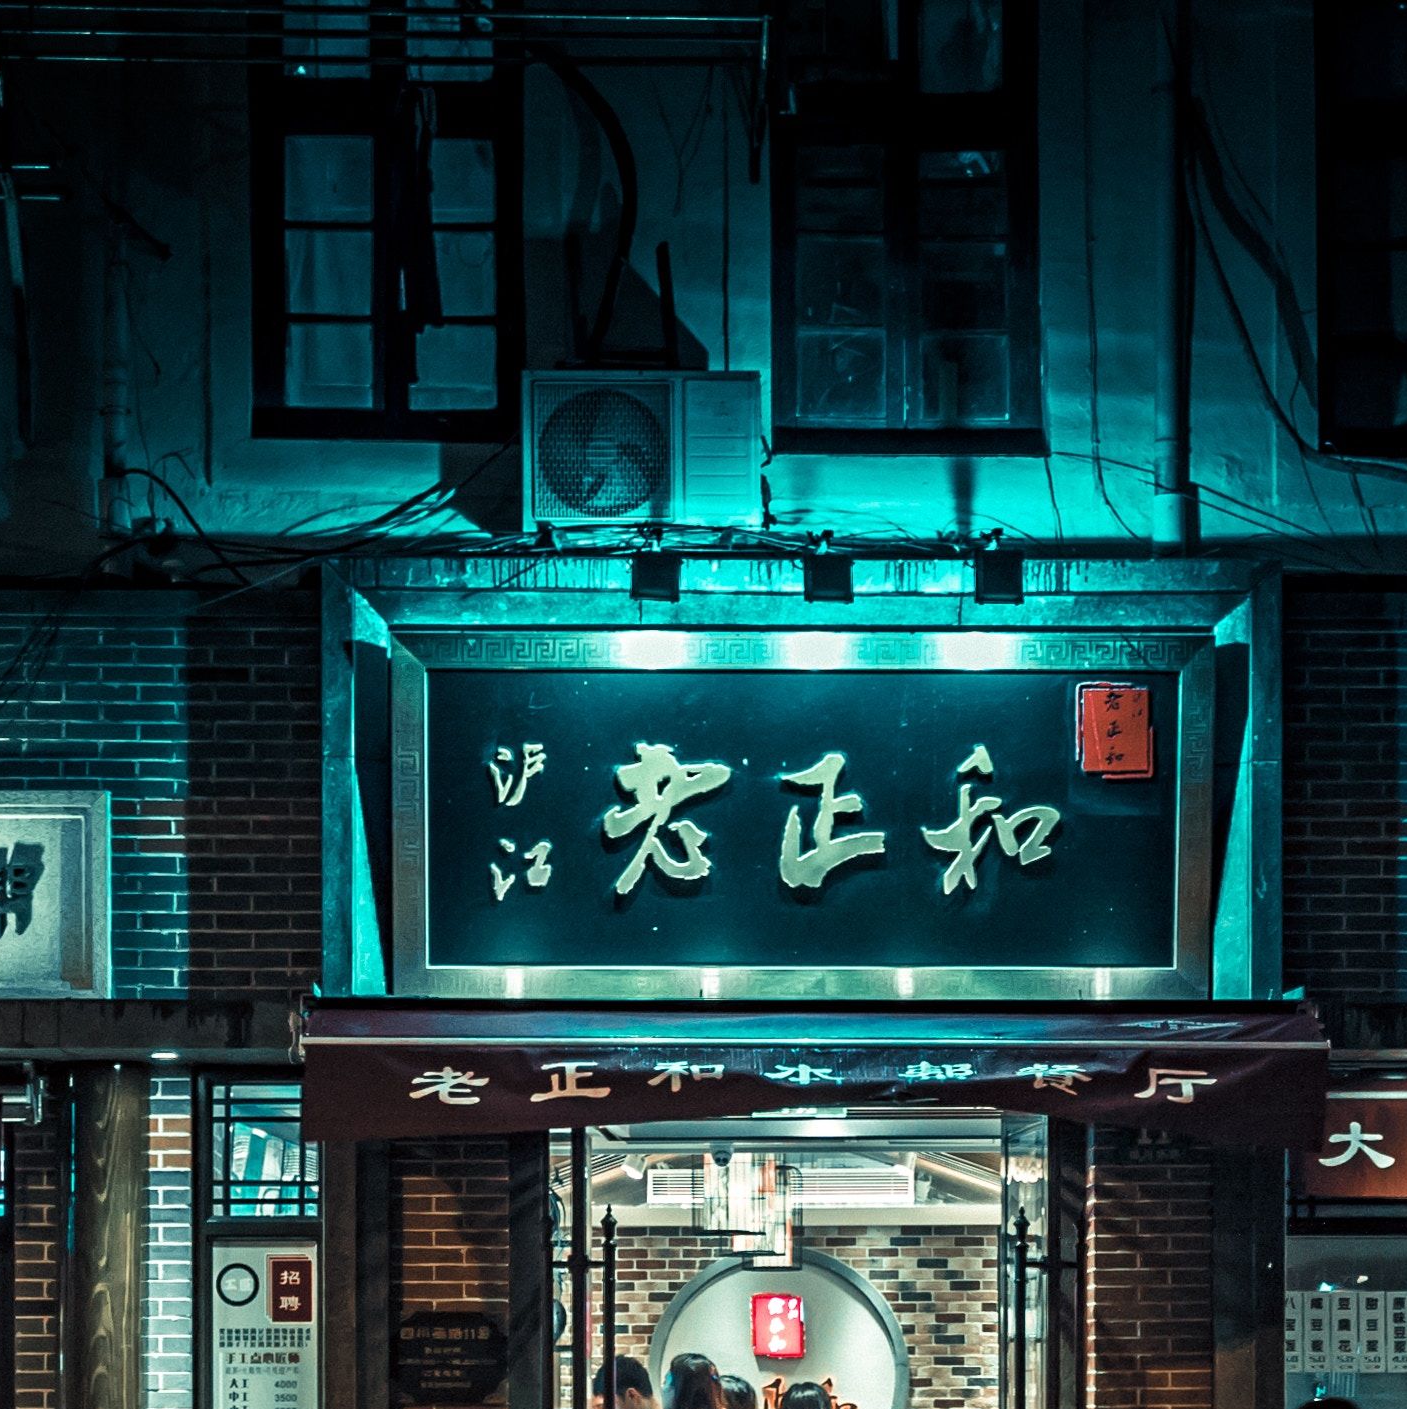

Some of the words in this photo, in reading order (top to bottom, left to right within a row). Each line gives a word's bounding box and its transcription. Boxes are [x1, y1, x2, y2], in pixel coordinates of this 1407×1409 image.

[604, 742, 1064, 895] 老正和
[279, 1270, 301, 1311] 招聘
